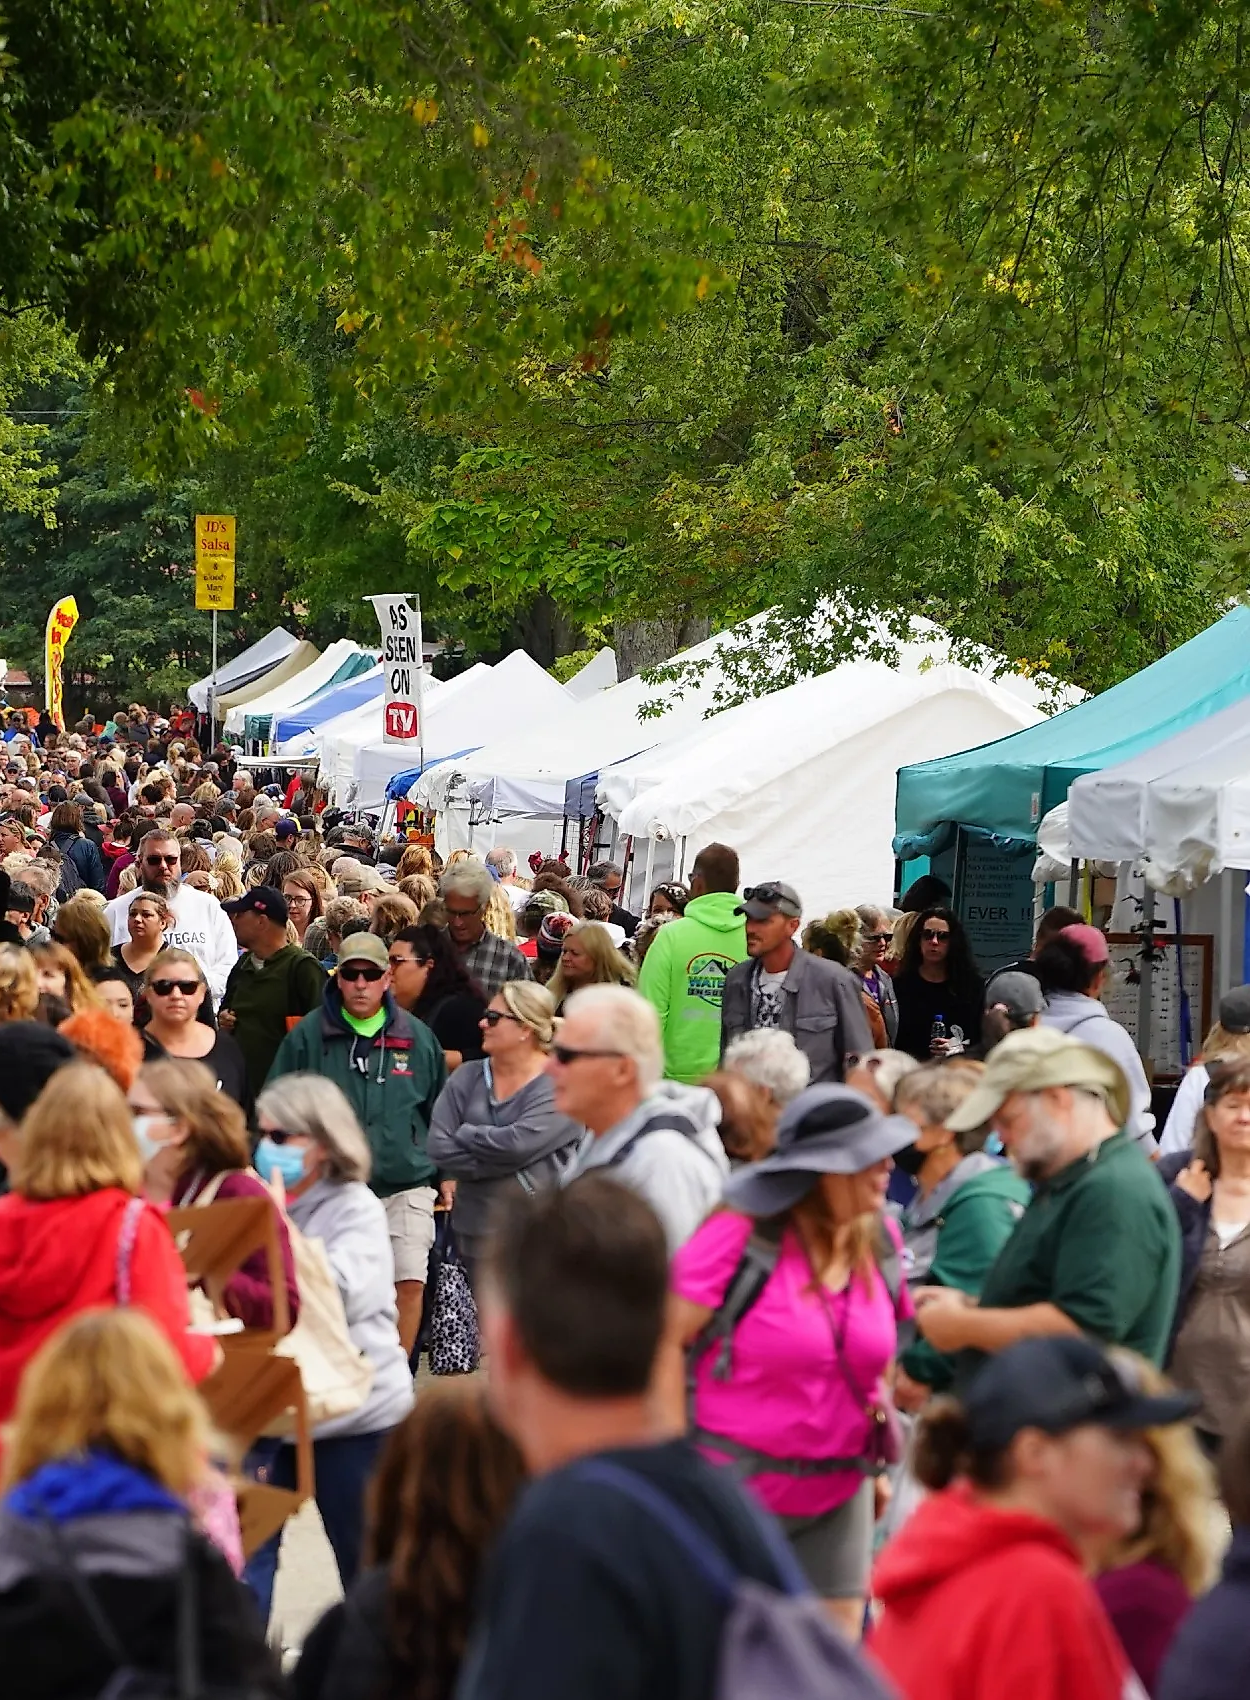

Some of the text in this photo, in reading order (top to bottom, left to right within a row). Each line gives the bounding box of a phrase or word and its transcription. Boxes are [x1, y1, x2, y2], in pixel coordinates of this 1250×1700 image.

[204, 521, 227, 533] JD's
[201, 538, 230, 551] Salsa
[389, 604, 407, 631] AS
[385, 635, 416, 663] SEEN
[390, 668, 410, 695] ON
[388, 707, 415, 732] TV
[968, 906, 1009, 920] EVER
[163, 931, 206, 945] VEGAS
